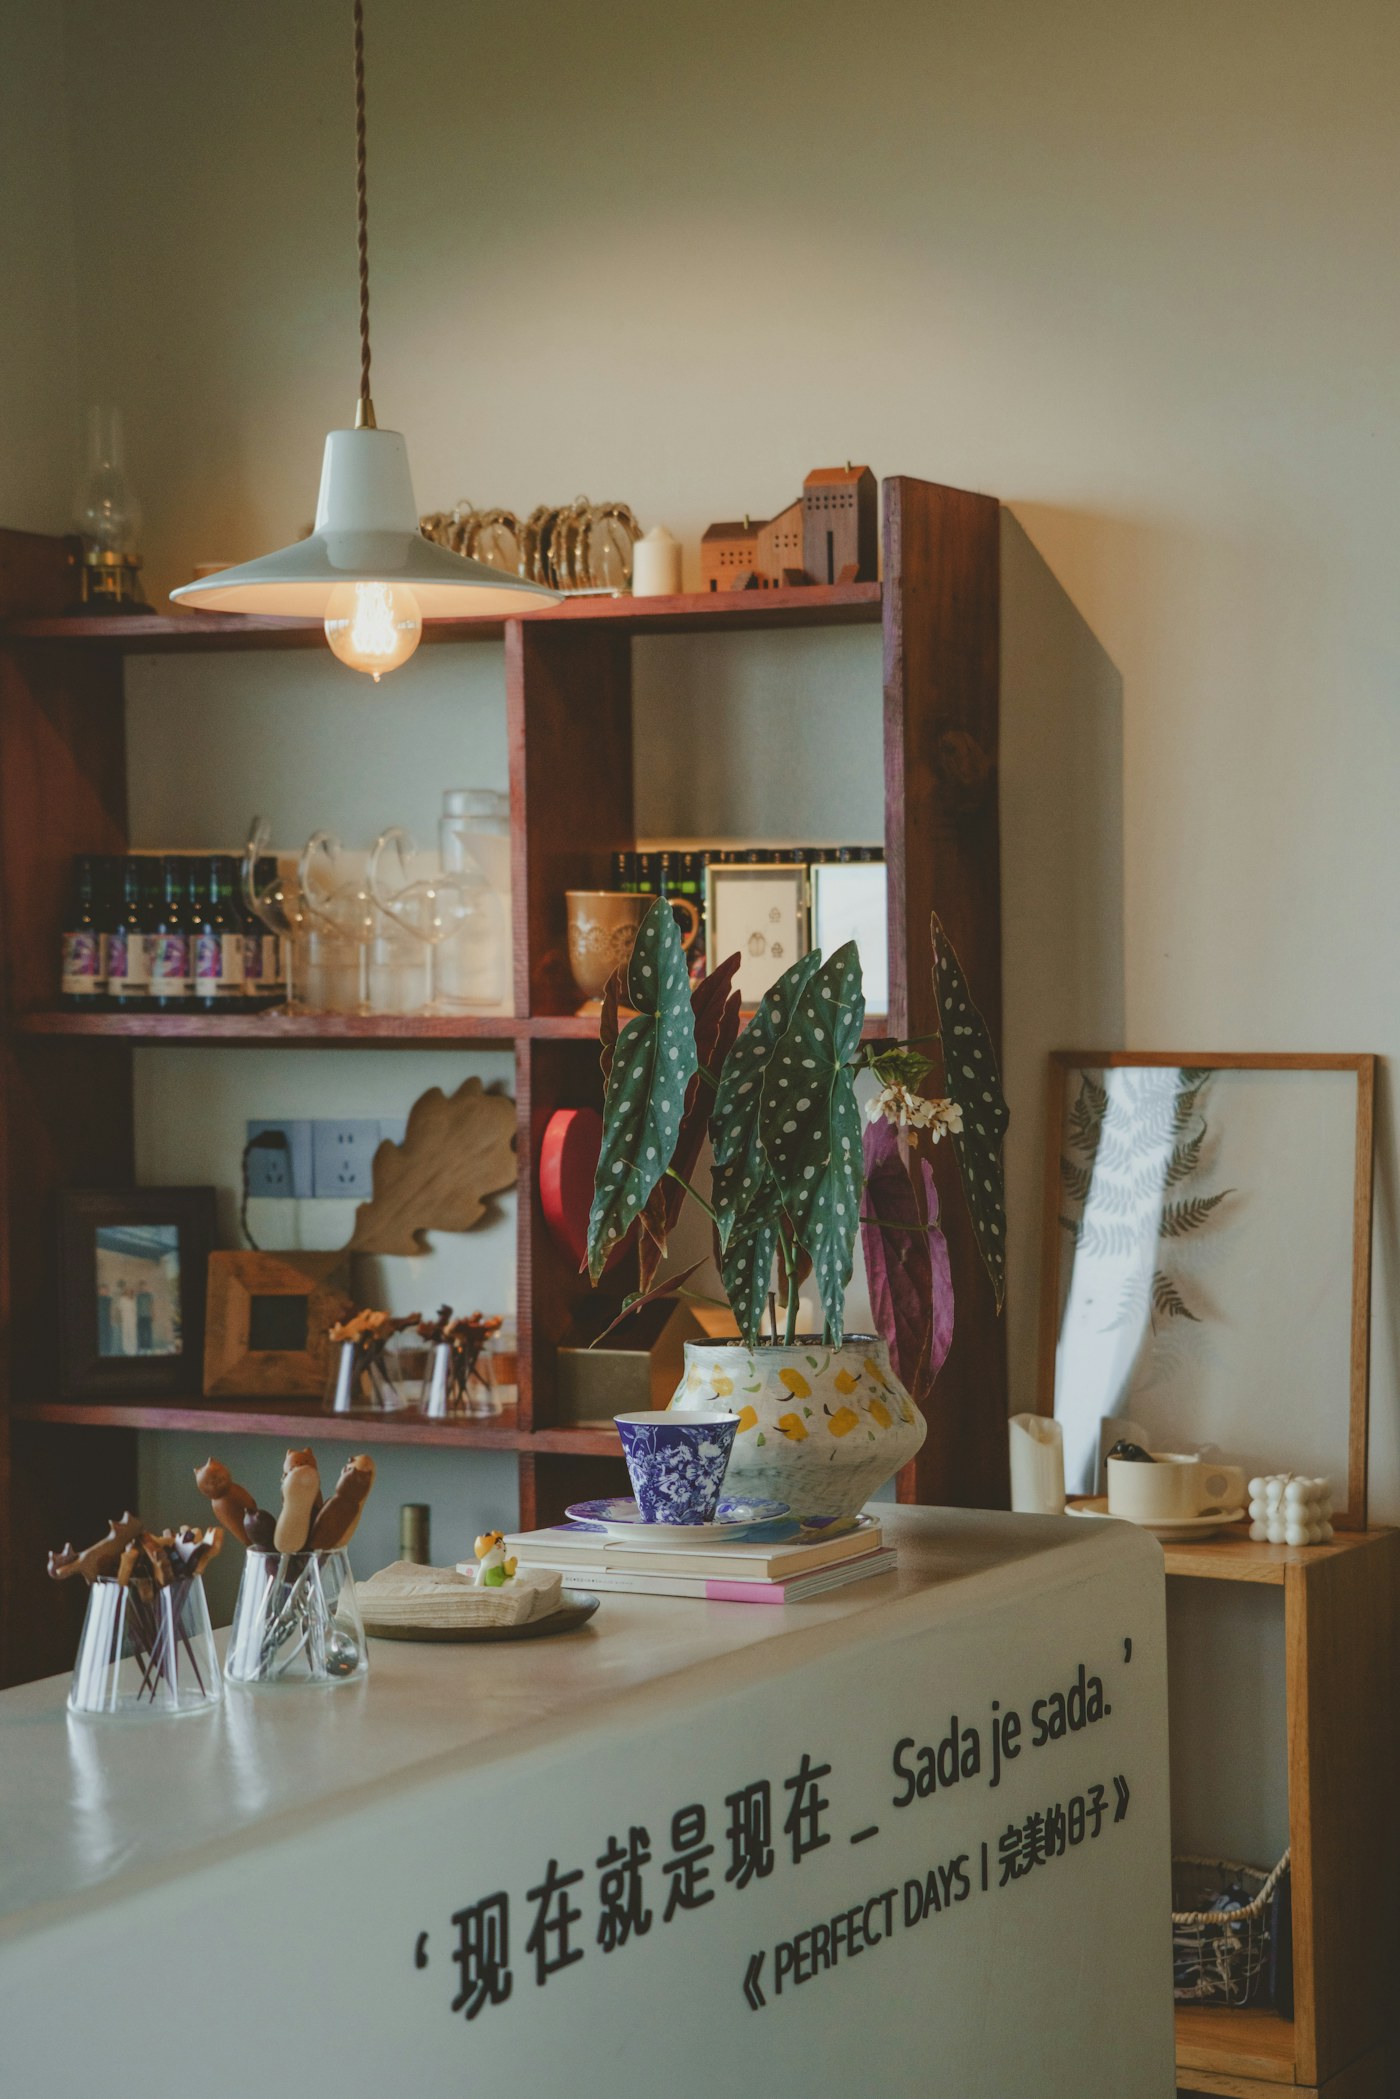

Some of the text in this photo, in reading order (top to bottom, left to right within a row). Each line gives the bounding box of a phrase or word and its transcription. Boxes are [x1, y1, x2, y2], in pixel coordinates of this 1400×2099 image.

[892, 1714, 981, 1809] Sada
[988, 1700, 1022, 1789] je
[903, 1853, 971, 1929] DAYS
